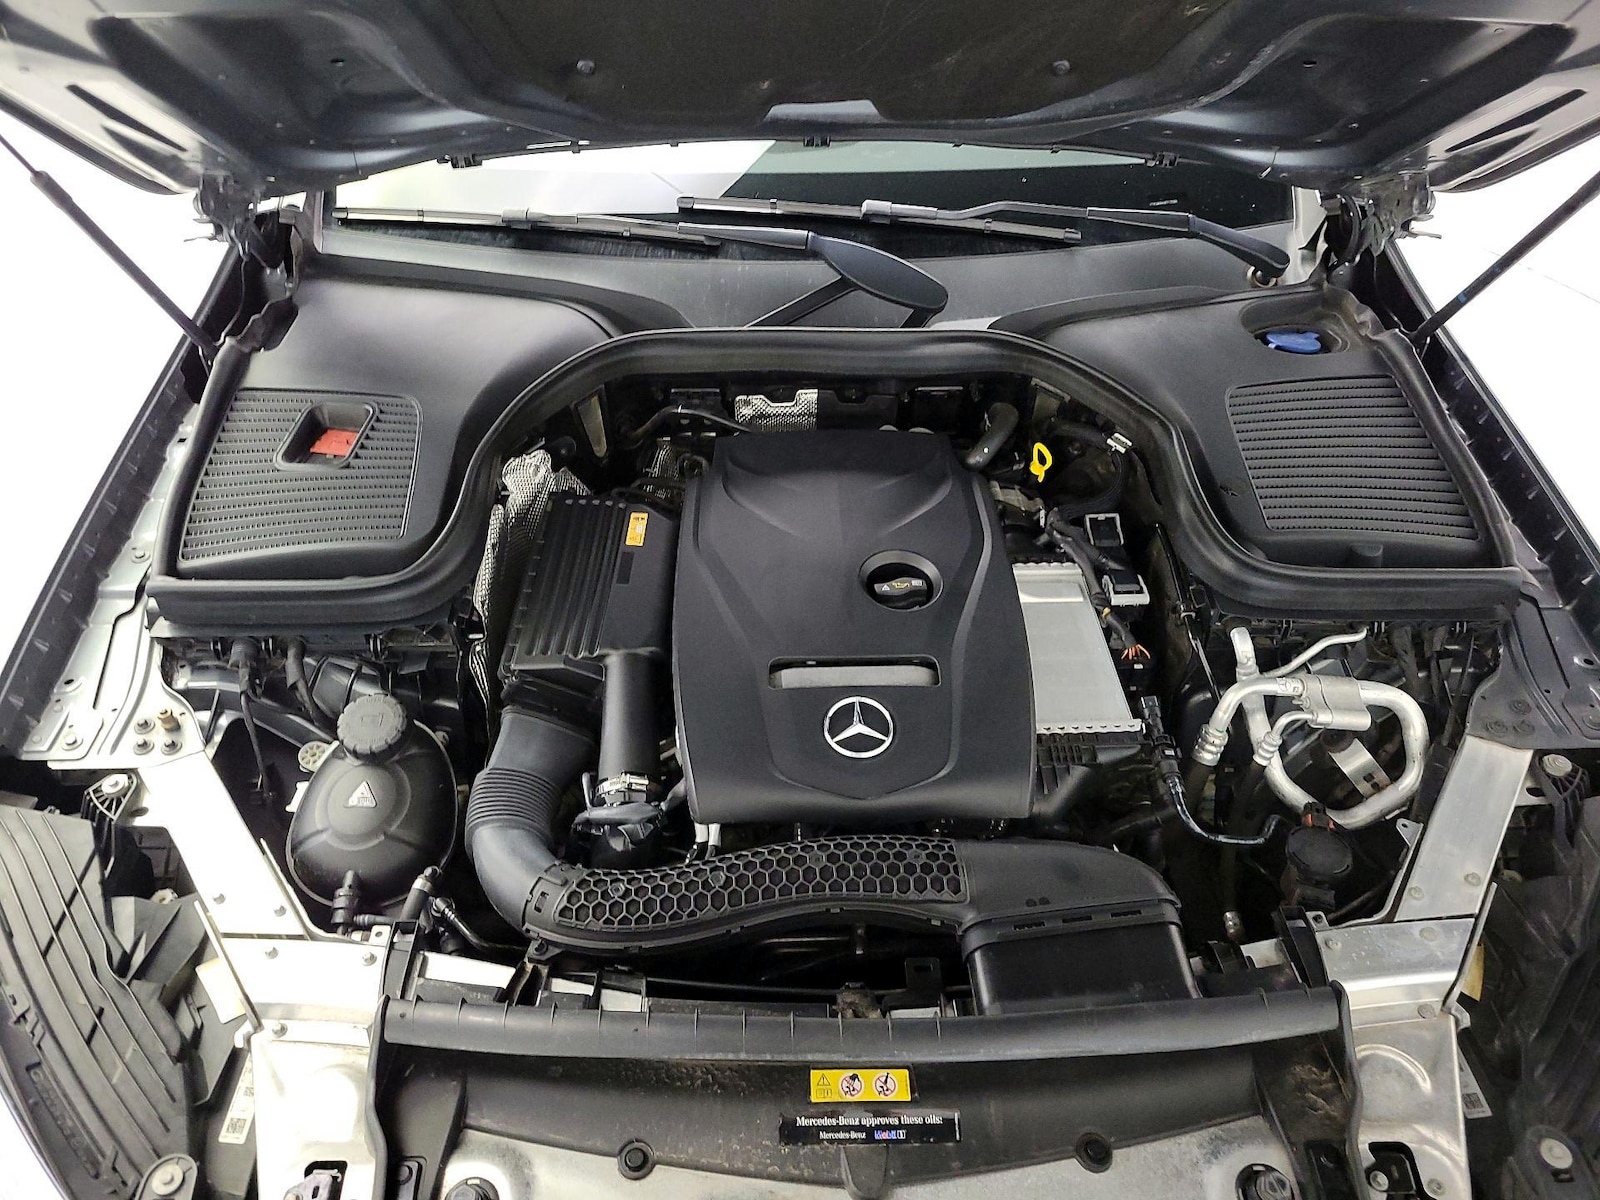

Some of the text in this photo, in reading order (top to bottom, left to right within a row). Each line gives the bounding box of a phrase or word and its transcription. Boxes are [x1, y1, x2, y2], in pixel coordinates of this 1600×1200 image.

[796, 1114, 943, 1127] Mercedes-Benz approves these oils:
[819, 1130, 866, 1140] Mercedes-Benz
